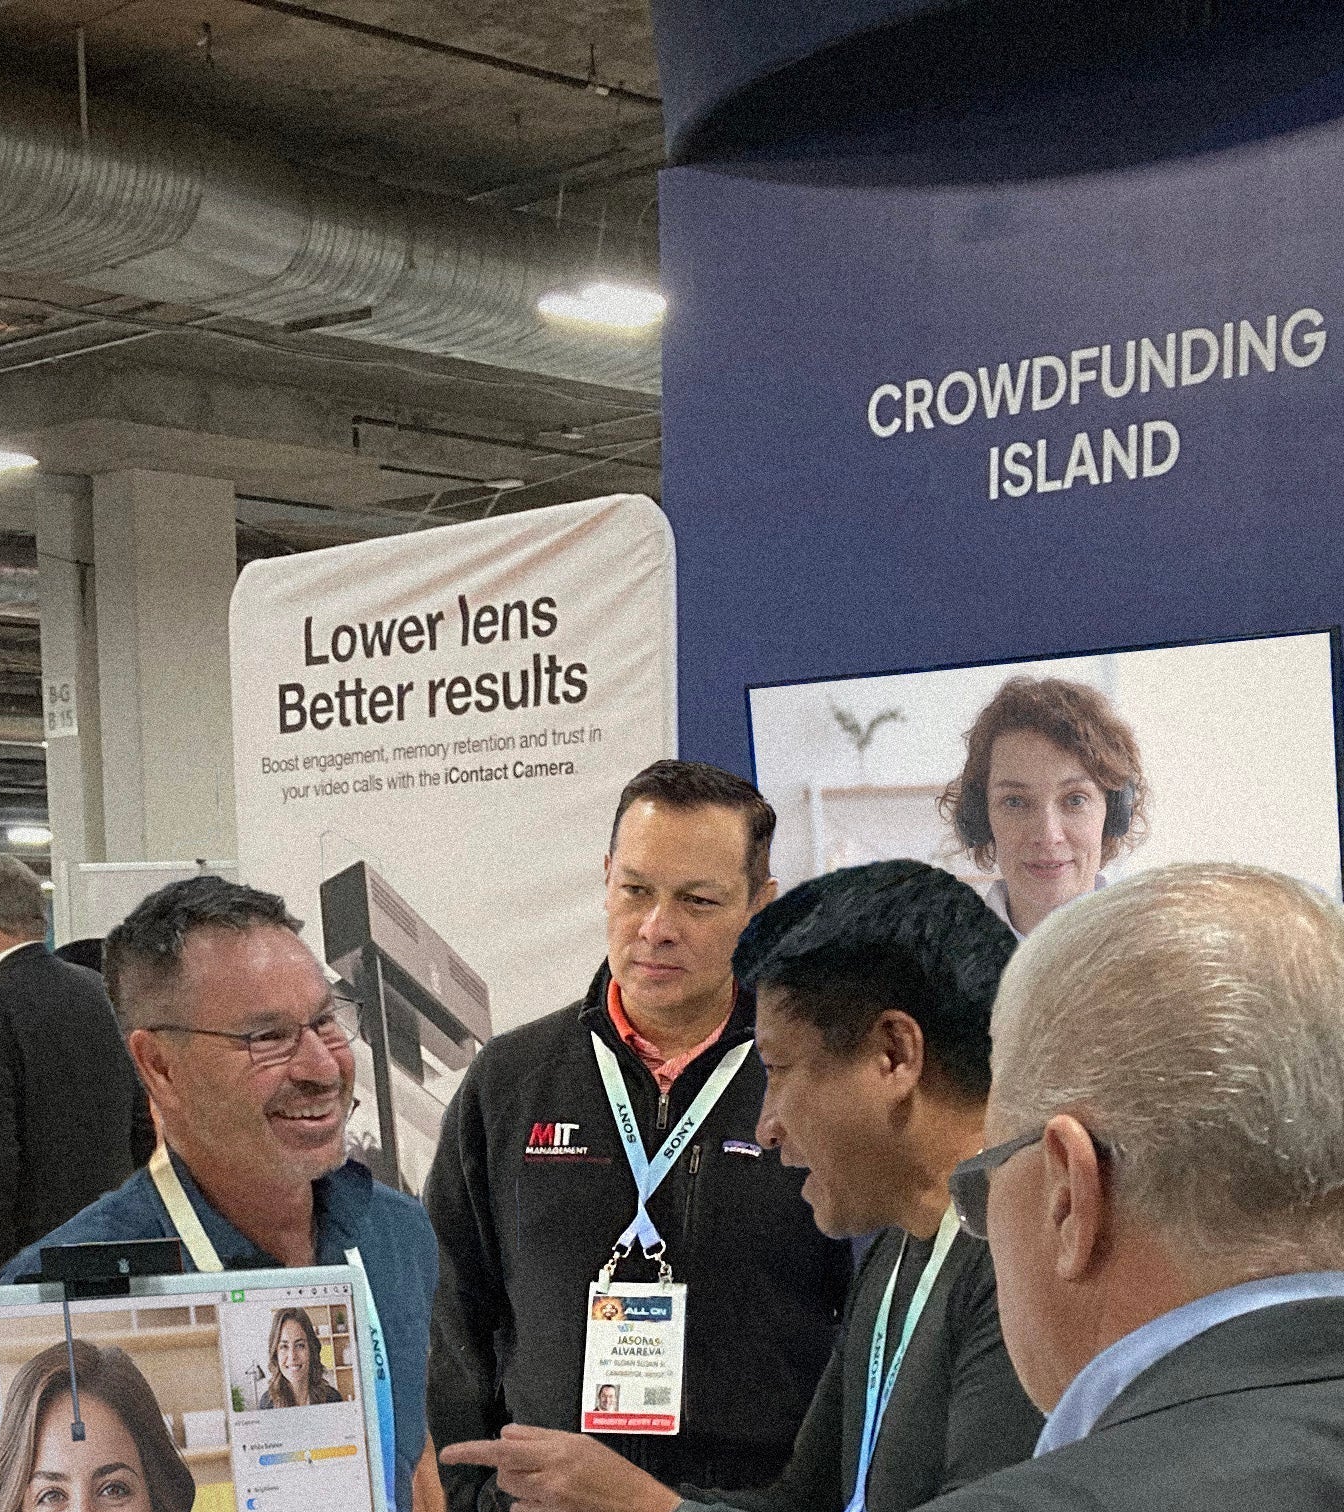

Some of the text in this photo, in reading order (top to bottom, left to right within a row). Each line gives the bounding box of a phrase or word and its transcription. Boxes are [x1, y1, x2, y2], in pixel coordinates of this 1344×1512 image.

[868, 308, 1327, 438] CROWDFUNDING
[988, 420, 1180, 500] ISLAND
[304, 594, 558, 667] Lower lens
[278, 653, 588, 734] Better results
[261, 726, 602, 775] Boost engagement, memory retention and trust in
[282, 785, 310, 804] your
[313, 779, 349, 797] video
[352, 775, 383, 794] calls
[387, 772, 416, 790] with
[418, 769, 441, 787] the
[444, 766, 509, 785] iContact
[528, 1122, 580, 1146] MIT
[616, 1102, 637, 1144] SONY
[664, 1117, 694, 1159] SONY
[525, 1146, 588, 1154] MANAGEMENT
[369, 1325, 386, 1381] SONY
[870, 1332, 883, 1389] SONY
